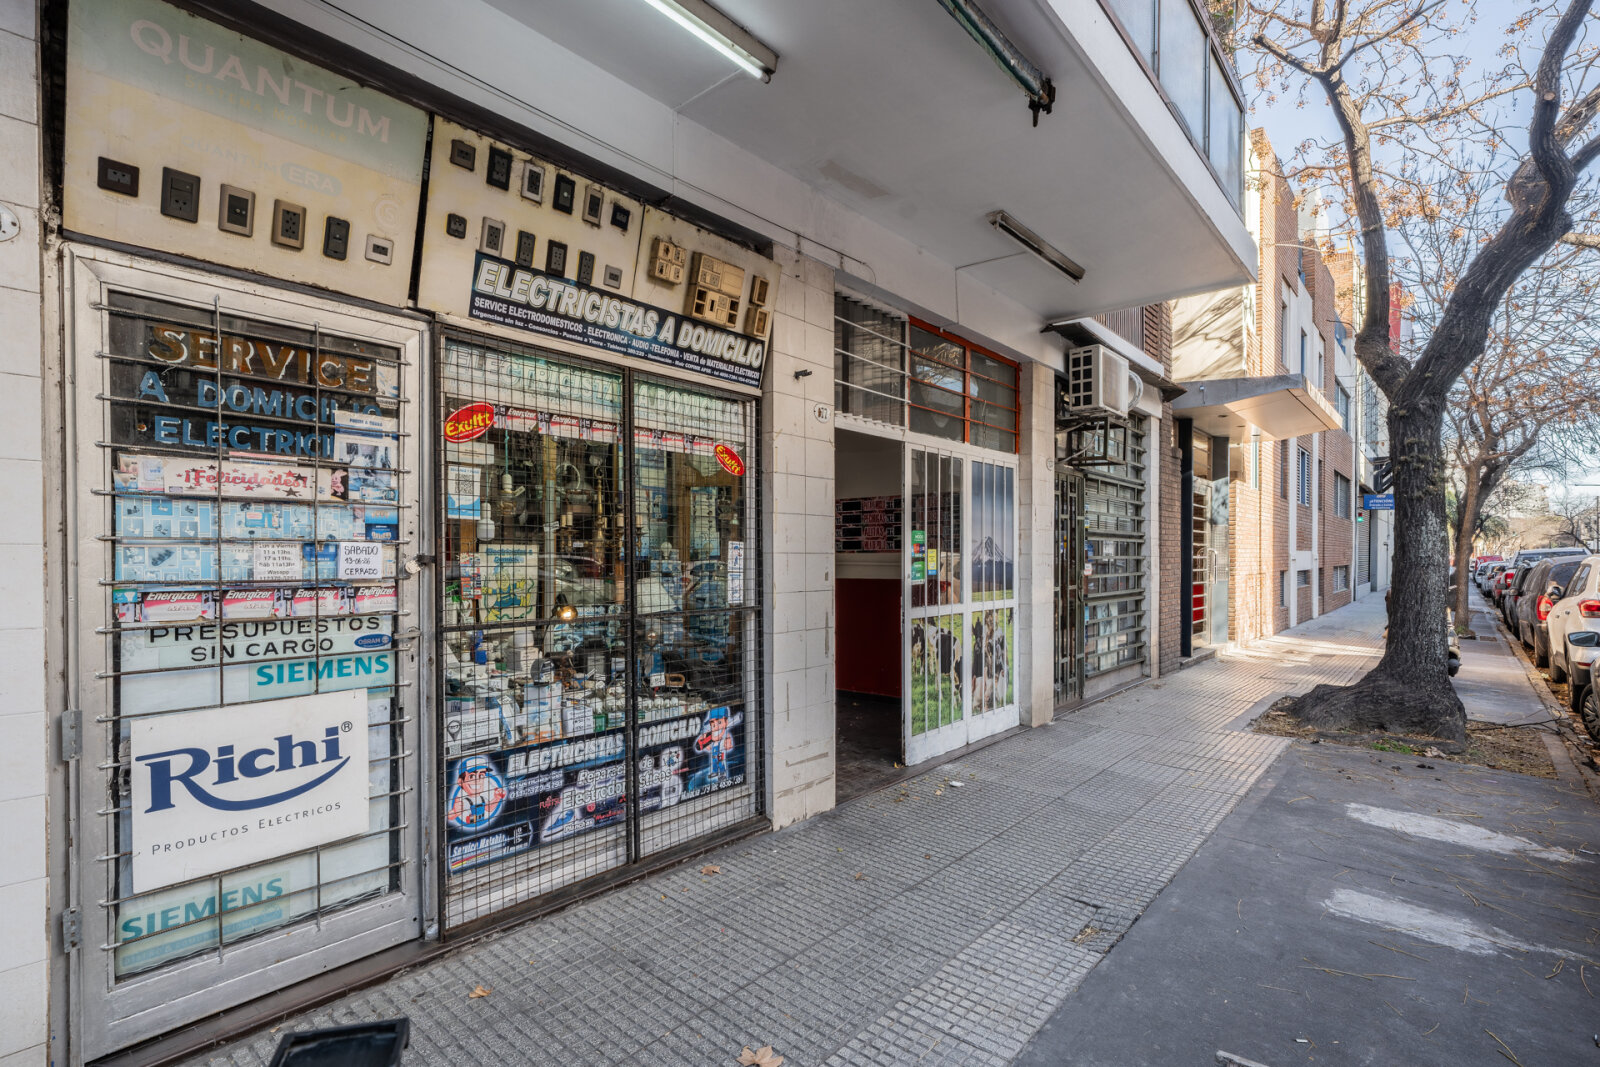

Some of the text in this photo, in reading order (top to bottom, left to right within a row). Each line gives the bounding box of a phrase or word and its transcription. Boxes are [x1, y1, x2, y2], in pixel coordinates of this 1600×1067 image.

[130, 19, 392, 143] QUANTUM
[288, 169, 336, 194] ERA
[472, 309, 504, 322] Urgencias
[504, 317, 514, 325] sin
[528, 323, 559, 336] Consorcios
[475, 259, 763, 369] ELECTRICISTAS A DOMICILIO
[474, 297, 508, 314] SERVICE
[508, 305, 584, 334] ELECTRODOMESTICOS
[587, 327, 628, 346] ELECTRONICA
[631, 339, 650, 350] AUDIO
[683, 352, 700, 363] VENTA
[706, 358, 735, 373] MATERIALES
[734, 364, 761, 380] ELECTRICOS
[149, 326, 372, 393] SERVICE
[139, 370, 170, 404] A
[446, 412, 491, 437] Exultt
[184, 468, 308, 489] ¡Felicidades!
[344, 545, 379, 556] SABADO
[344, 567, 378, 576] CERRADO
[145, 591, 198, 603] Energizer
[225, 589, 273, 601] Energizer
[358, 587, 395, 598] Energizer
[150, 616, 380, 643] PRESUPUESTOS
[358, 637, 381, 645] OSRAM
[191, 637, 334, 662] SIN CARGO
[256, 654, 389, 686] SIEMENS
[507, 732, 625, 778] ELECTRICISTAS
[638, 716, 702, 749] DOMICILIO
[134, 725, 351, 814] Richi
[641, 754, 653, 770] de
[151, 801, 342, 855] PRODUCTOS ELECTRICOS
[121, 877, 284, 942] SIEMENS
